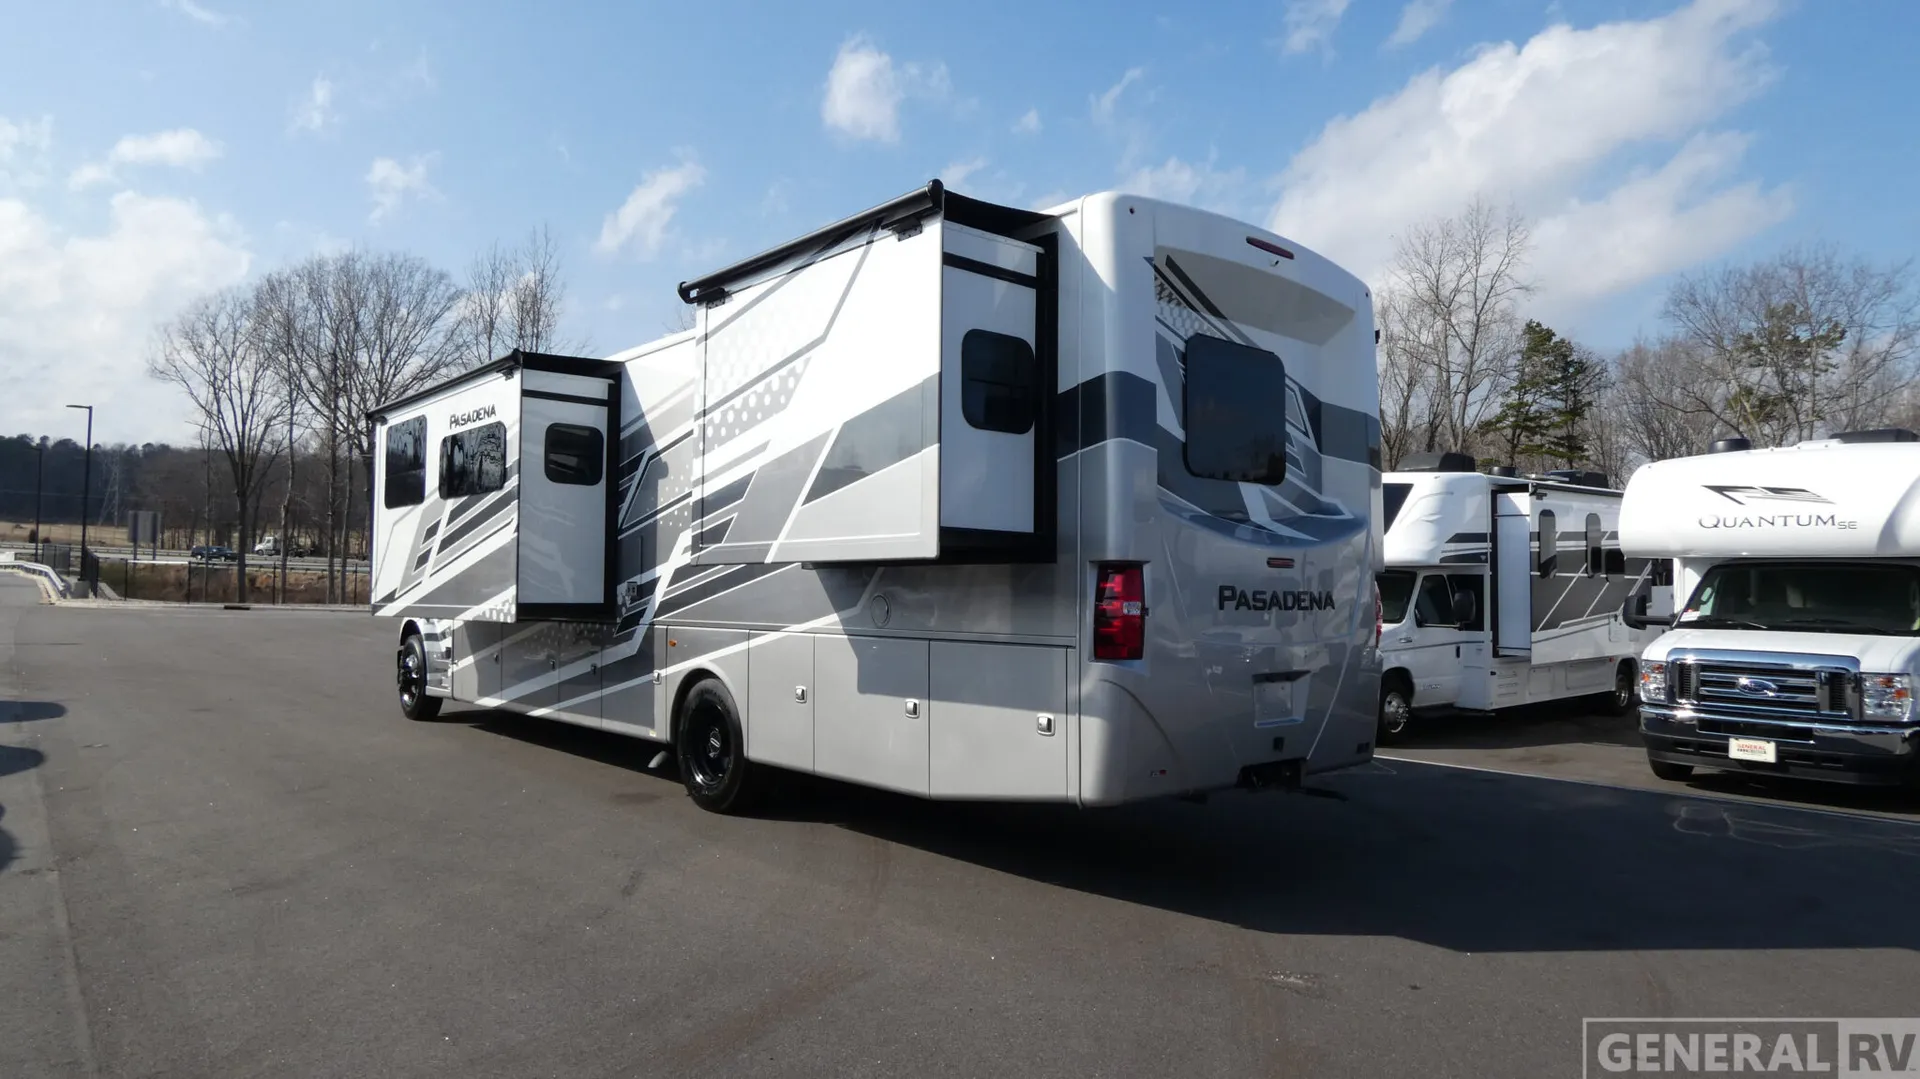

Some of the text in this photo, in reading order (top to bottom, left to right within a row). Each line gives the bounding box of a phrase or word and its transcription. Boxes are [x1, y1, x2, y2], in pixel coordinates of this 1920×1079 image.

[449, 403, 497, 430] PASADENA
[1698, 514, 1836, 529] QUANTUM
[1218, 585, 1336, 611] PASADENA
